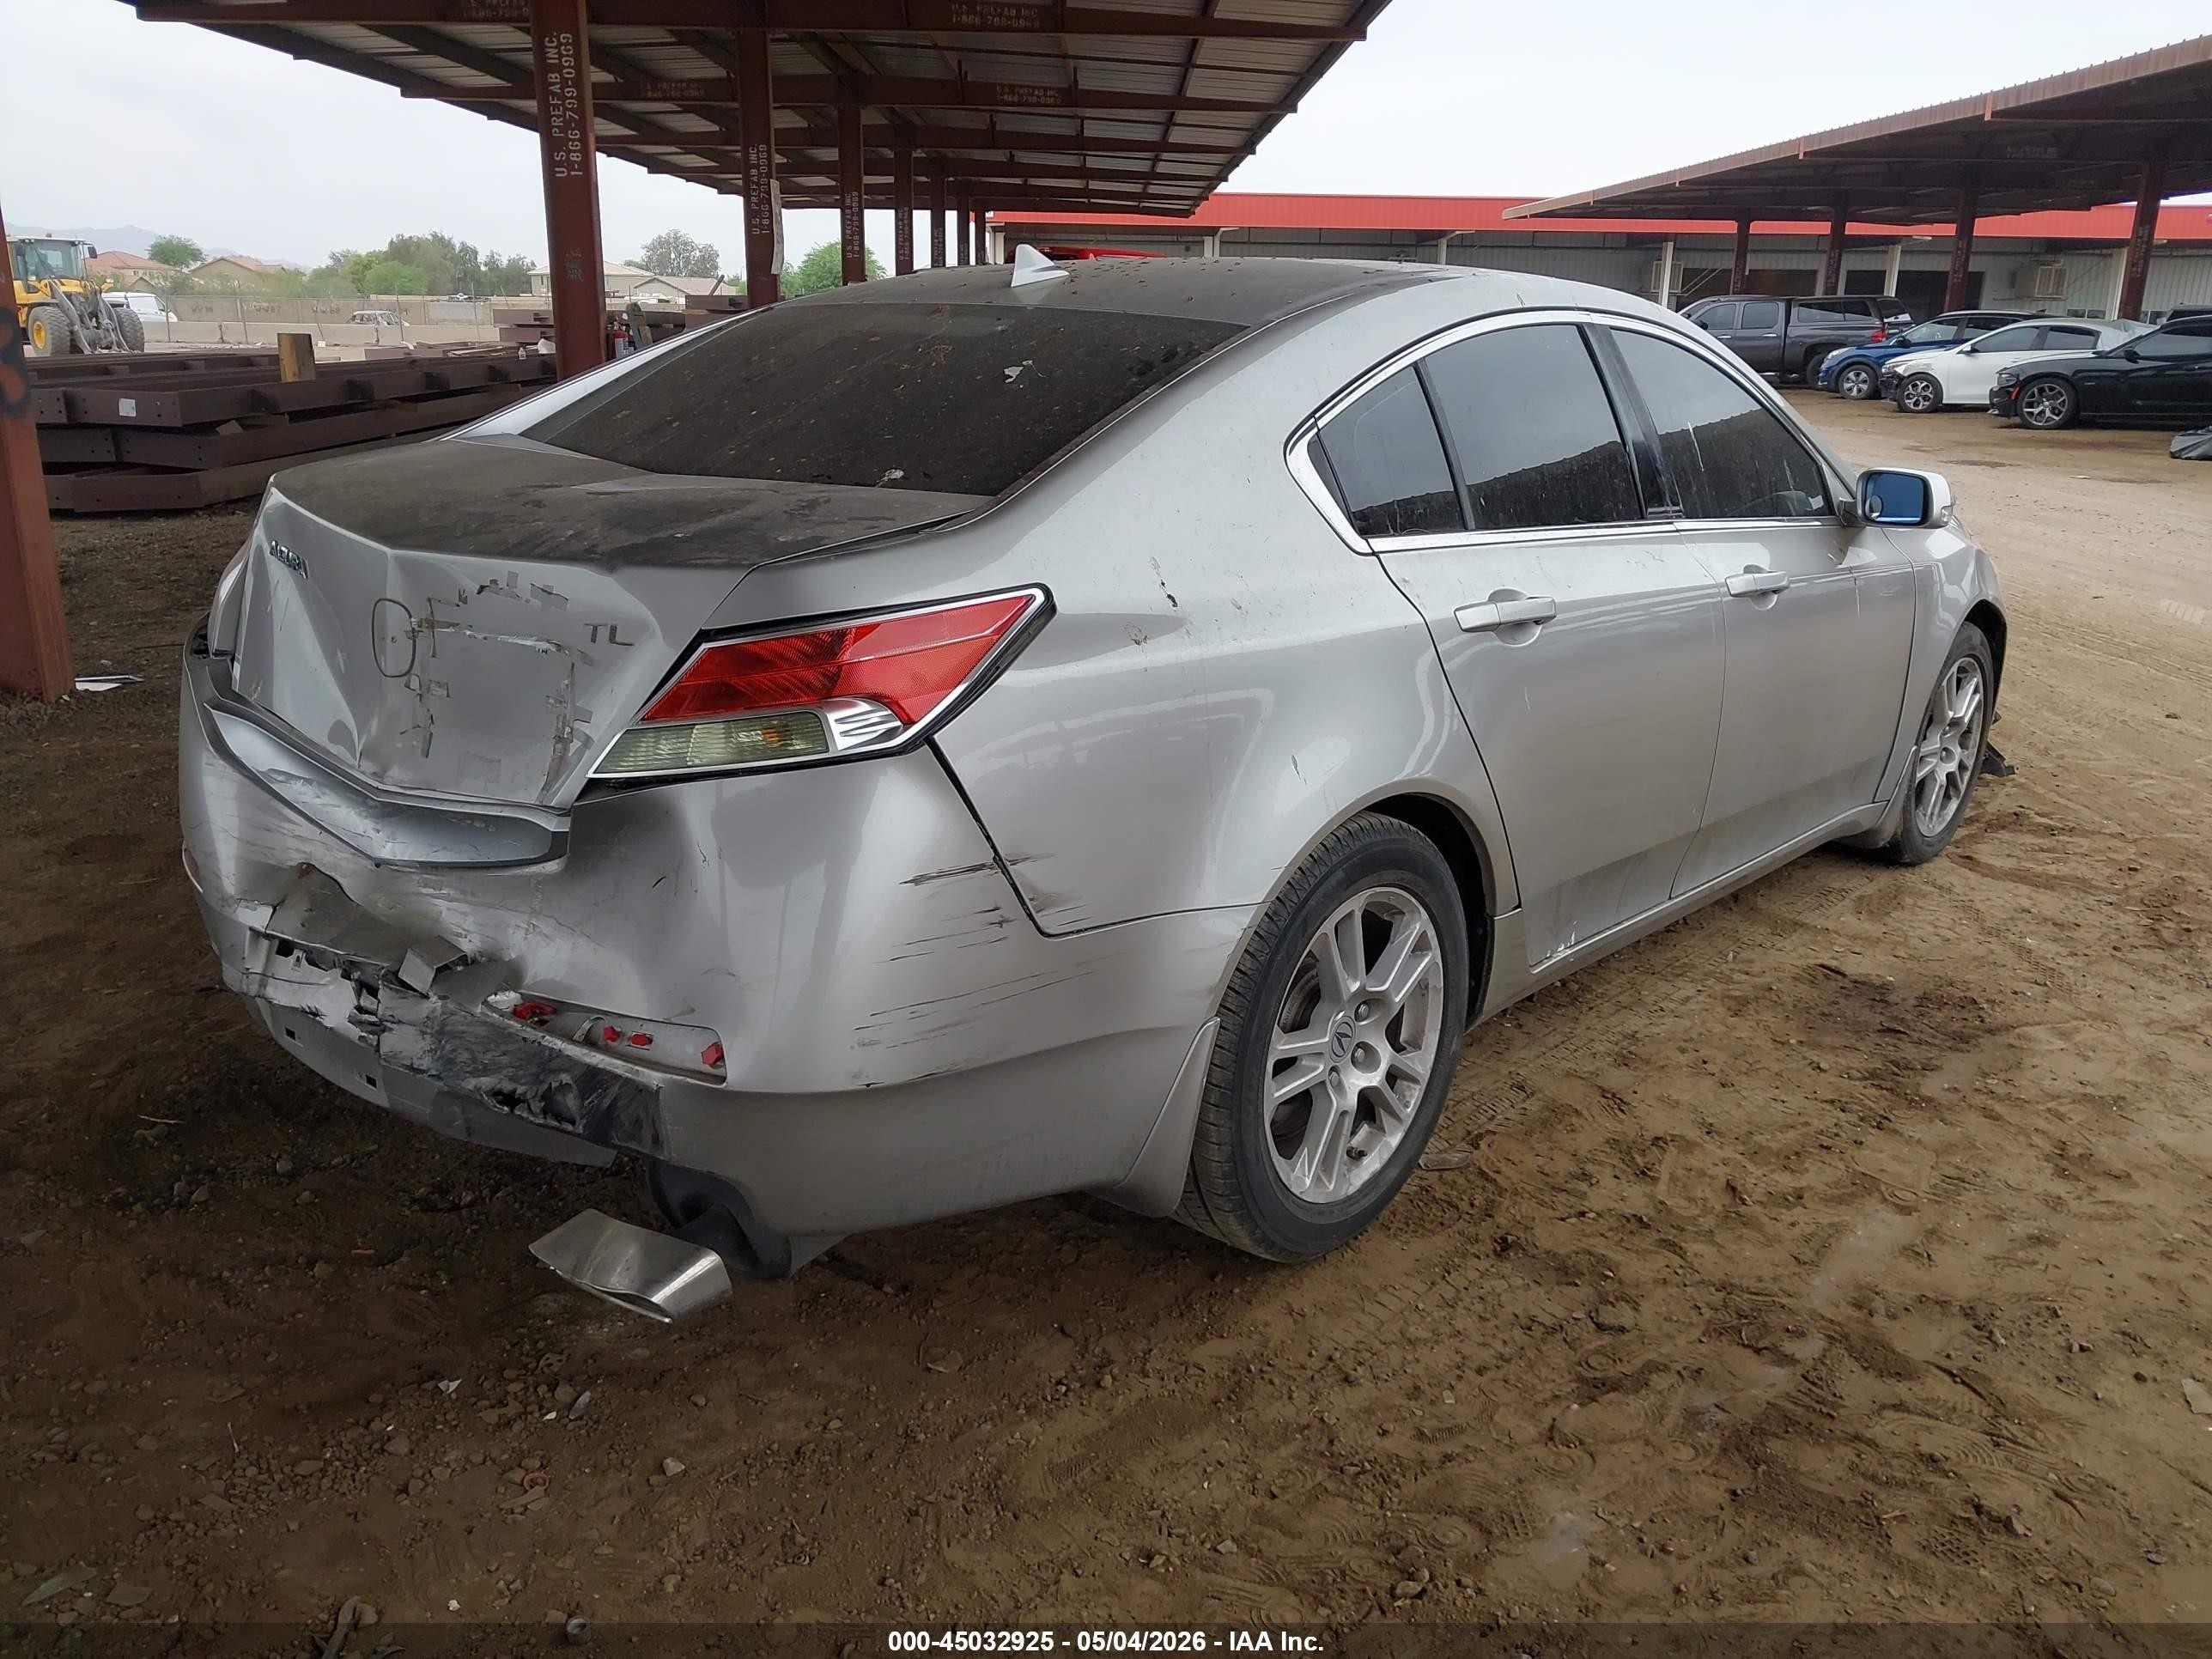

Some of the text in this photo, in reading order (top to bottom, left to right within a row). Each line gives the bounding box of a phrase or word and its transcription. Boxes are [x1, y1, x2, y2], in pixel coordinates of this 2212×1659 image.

[544, 31, 559, 64] INC.
[547, 73, 564, 137] PREFAB
[560, 33, 583, 175] 1-866-799-0969
[750, 168, 759, 210] PREFAB
[758, 144, 769, 234] 1-866-799-0969
[270, 539, 309, 580] ACURA
[584, 623, 635, 646] TL
